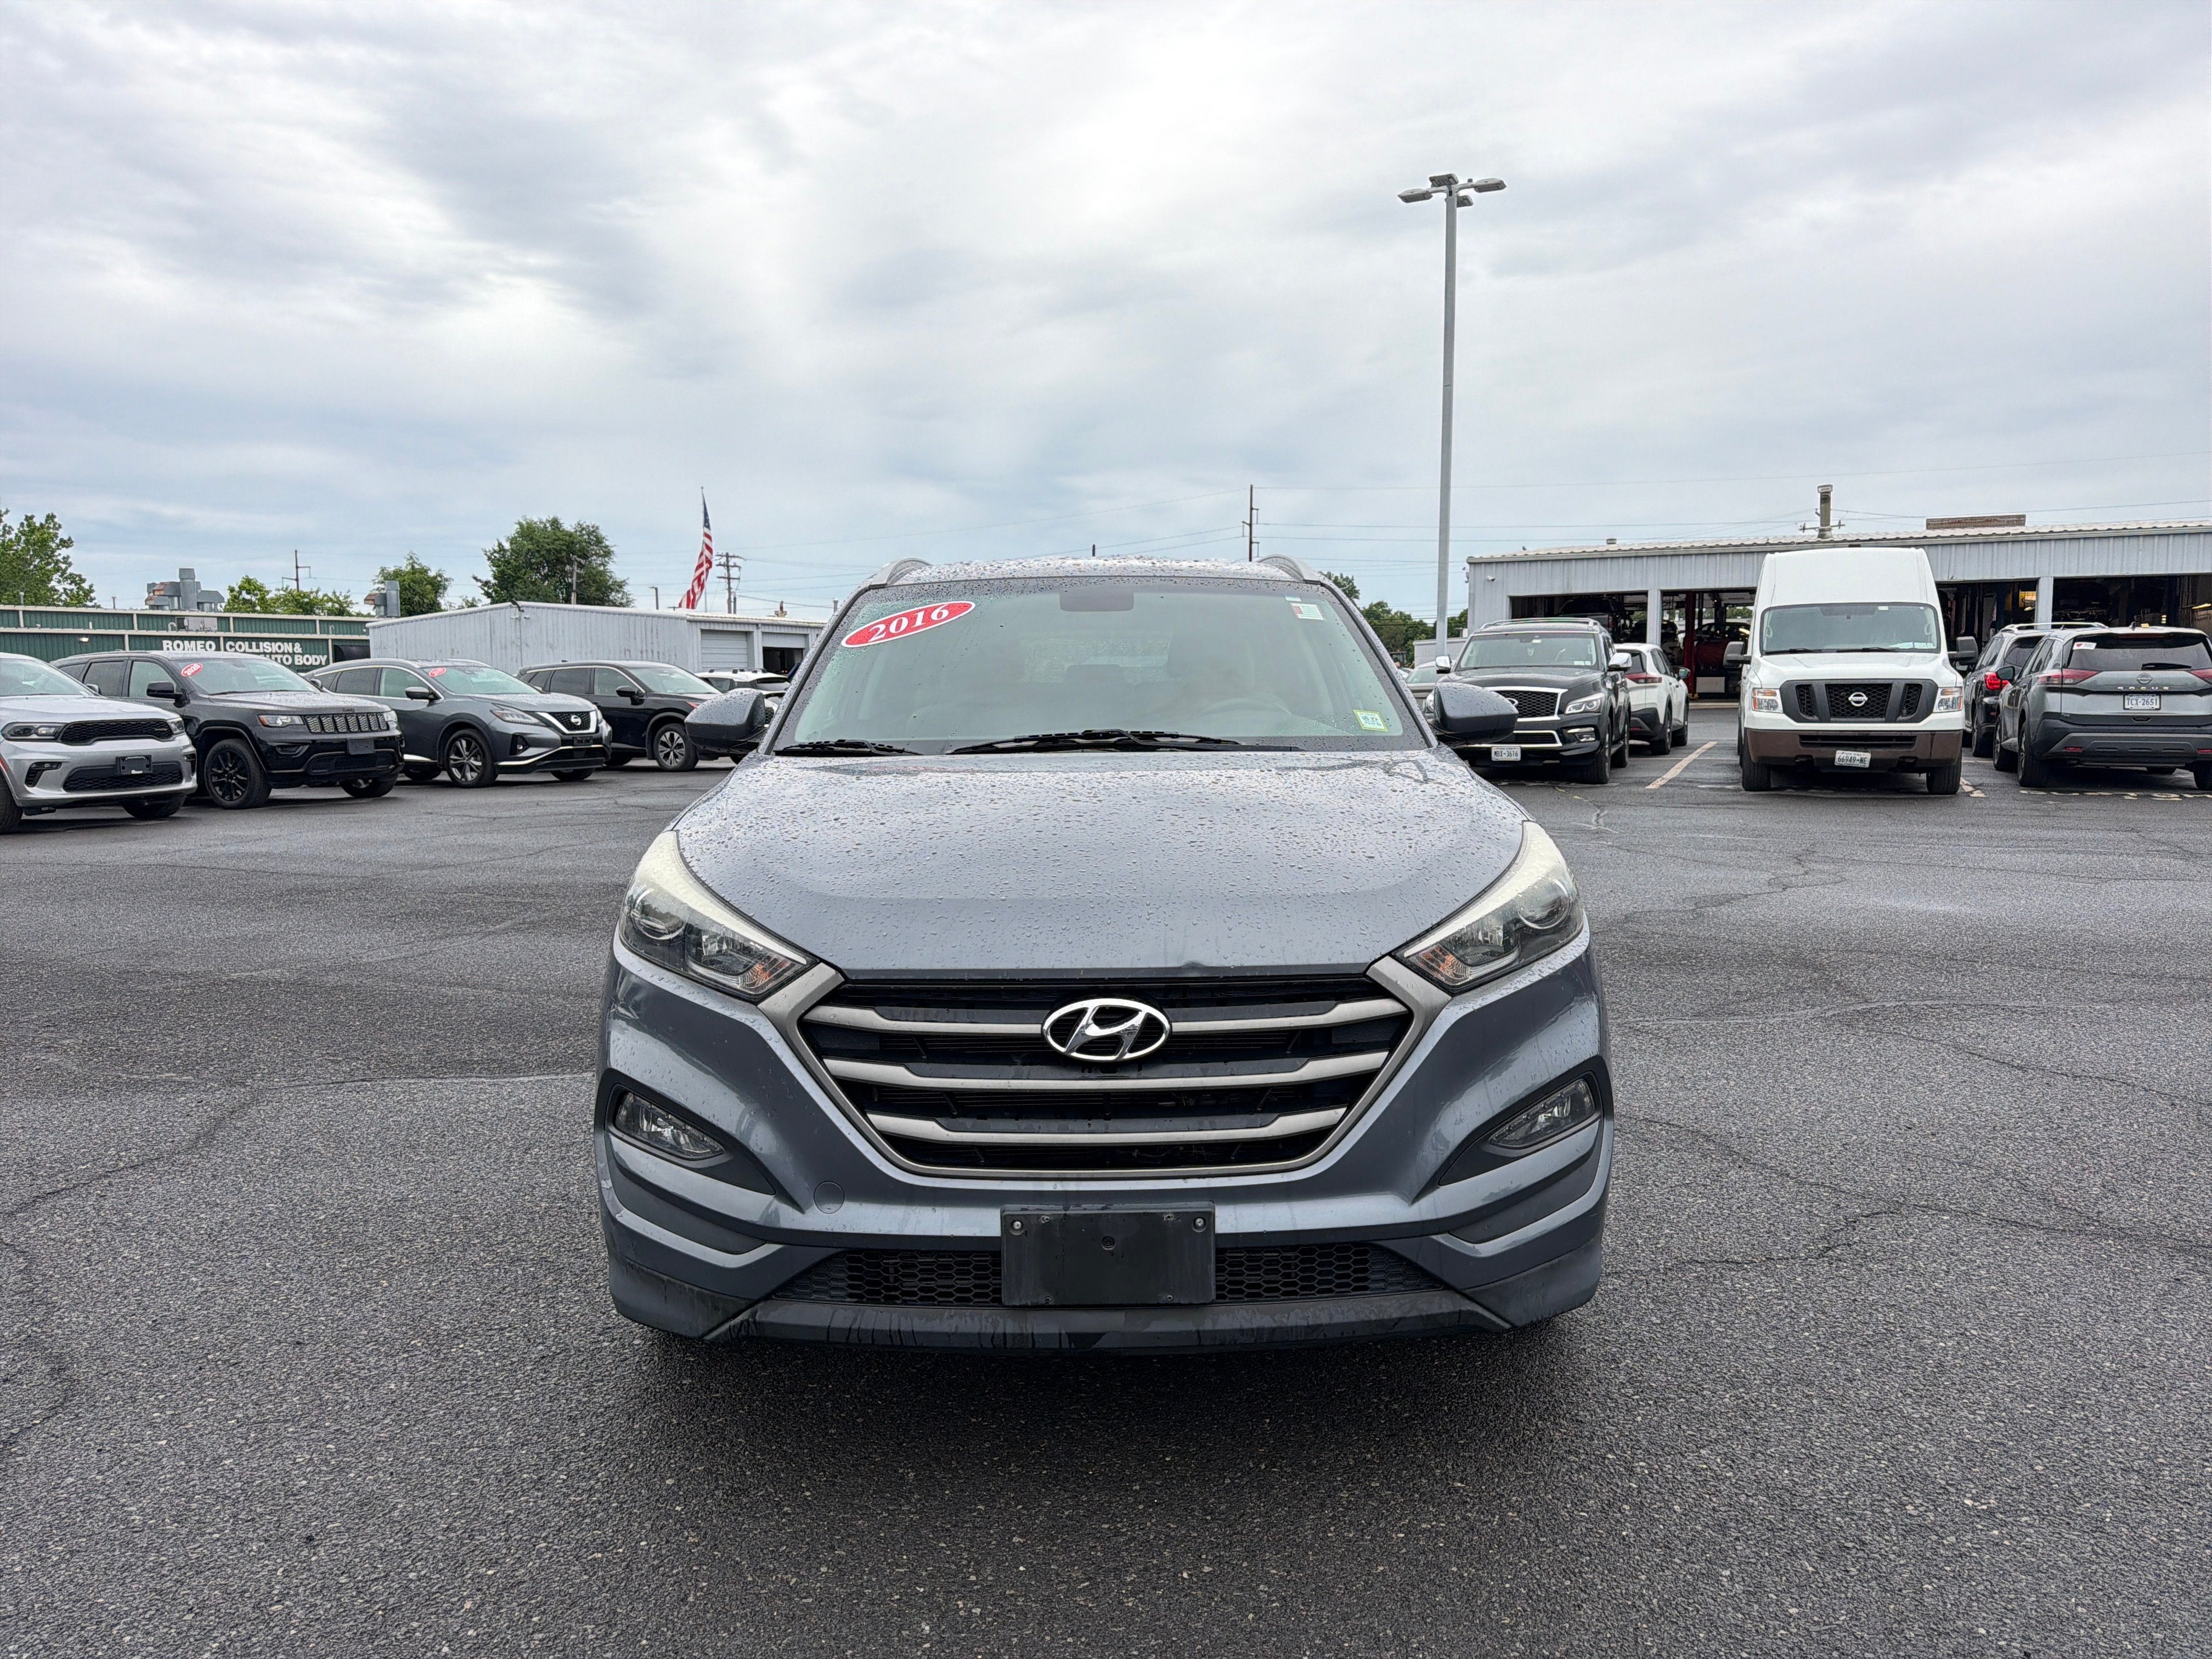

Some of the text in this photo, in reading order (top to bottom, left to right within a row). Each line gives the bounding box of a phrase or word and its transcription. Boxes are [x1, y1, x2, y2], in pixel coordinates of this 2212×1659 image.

[868, 603, 949, 642] 2016
[162, 640, 216, 652] ROMEO
[225, 641, 292, 653] COLLISION
[259, 654, 328, 665] UTO BODY
